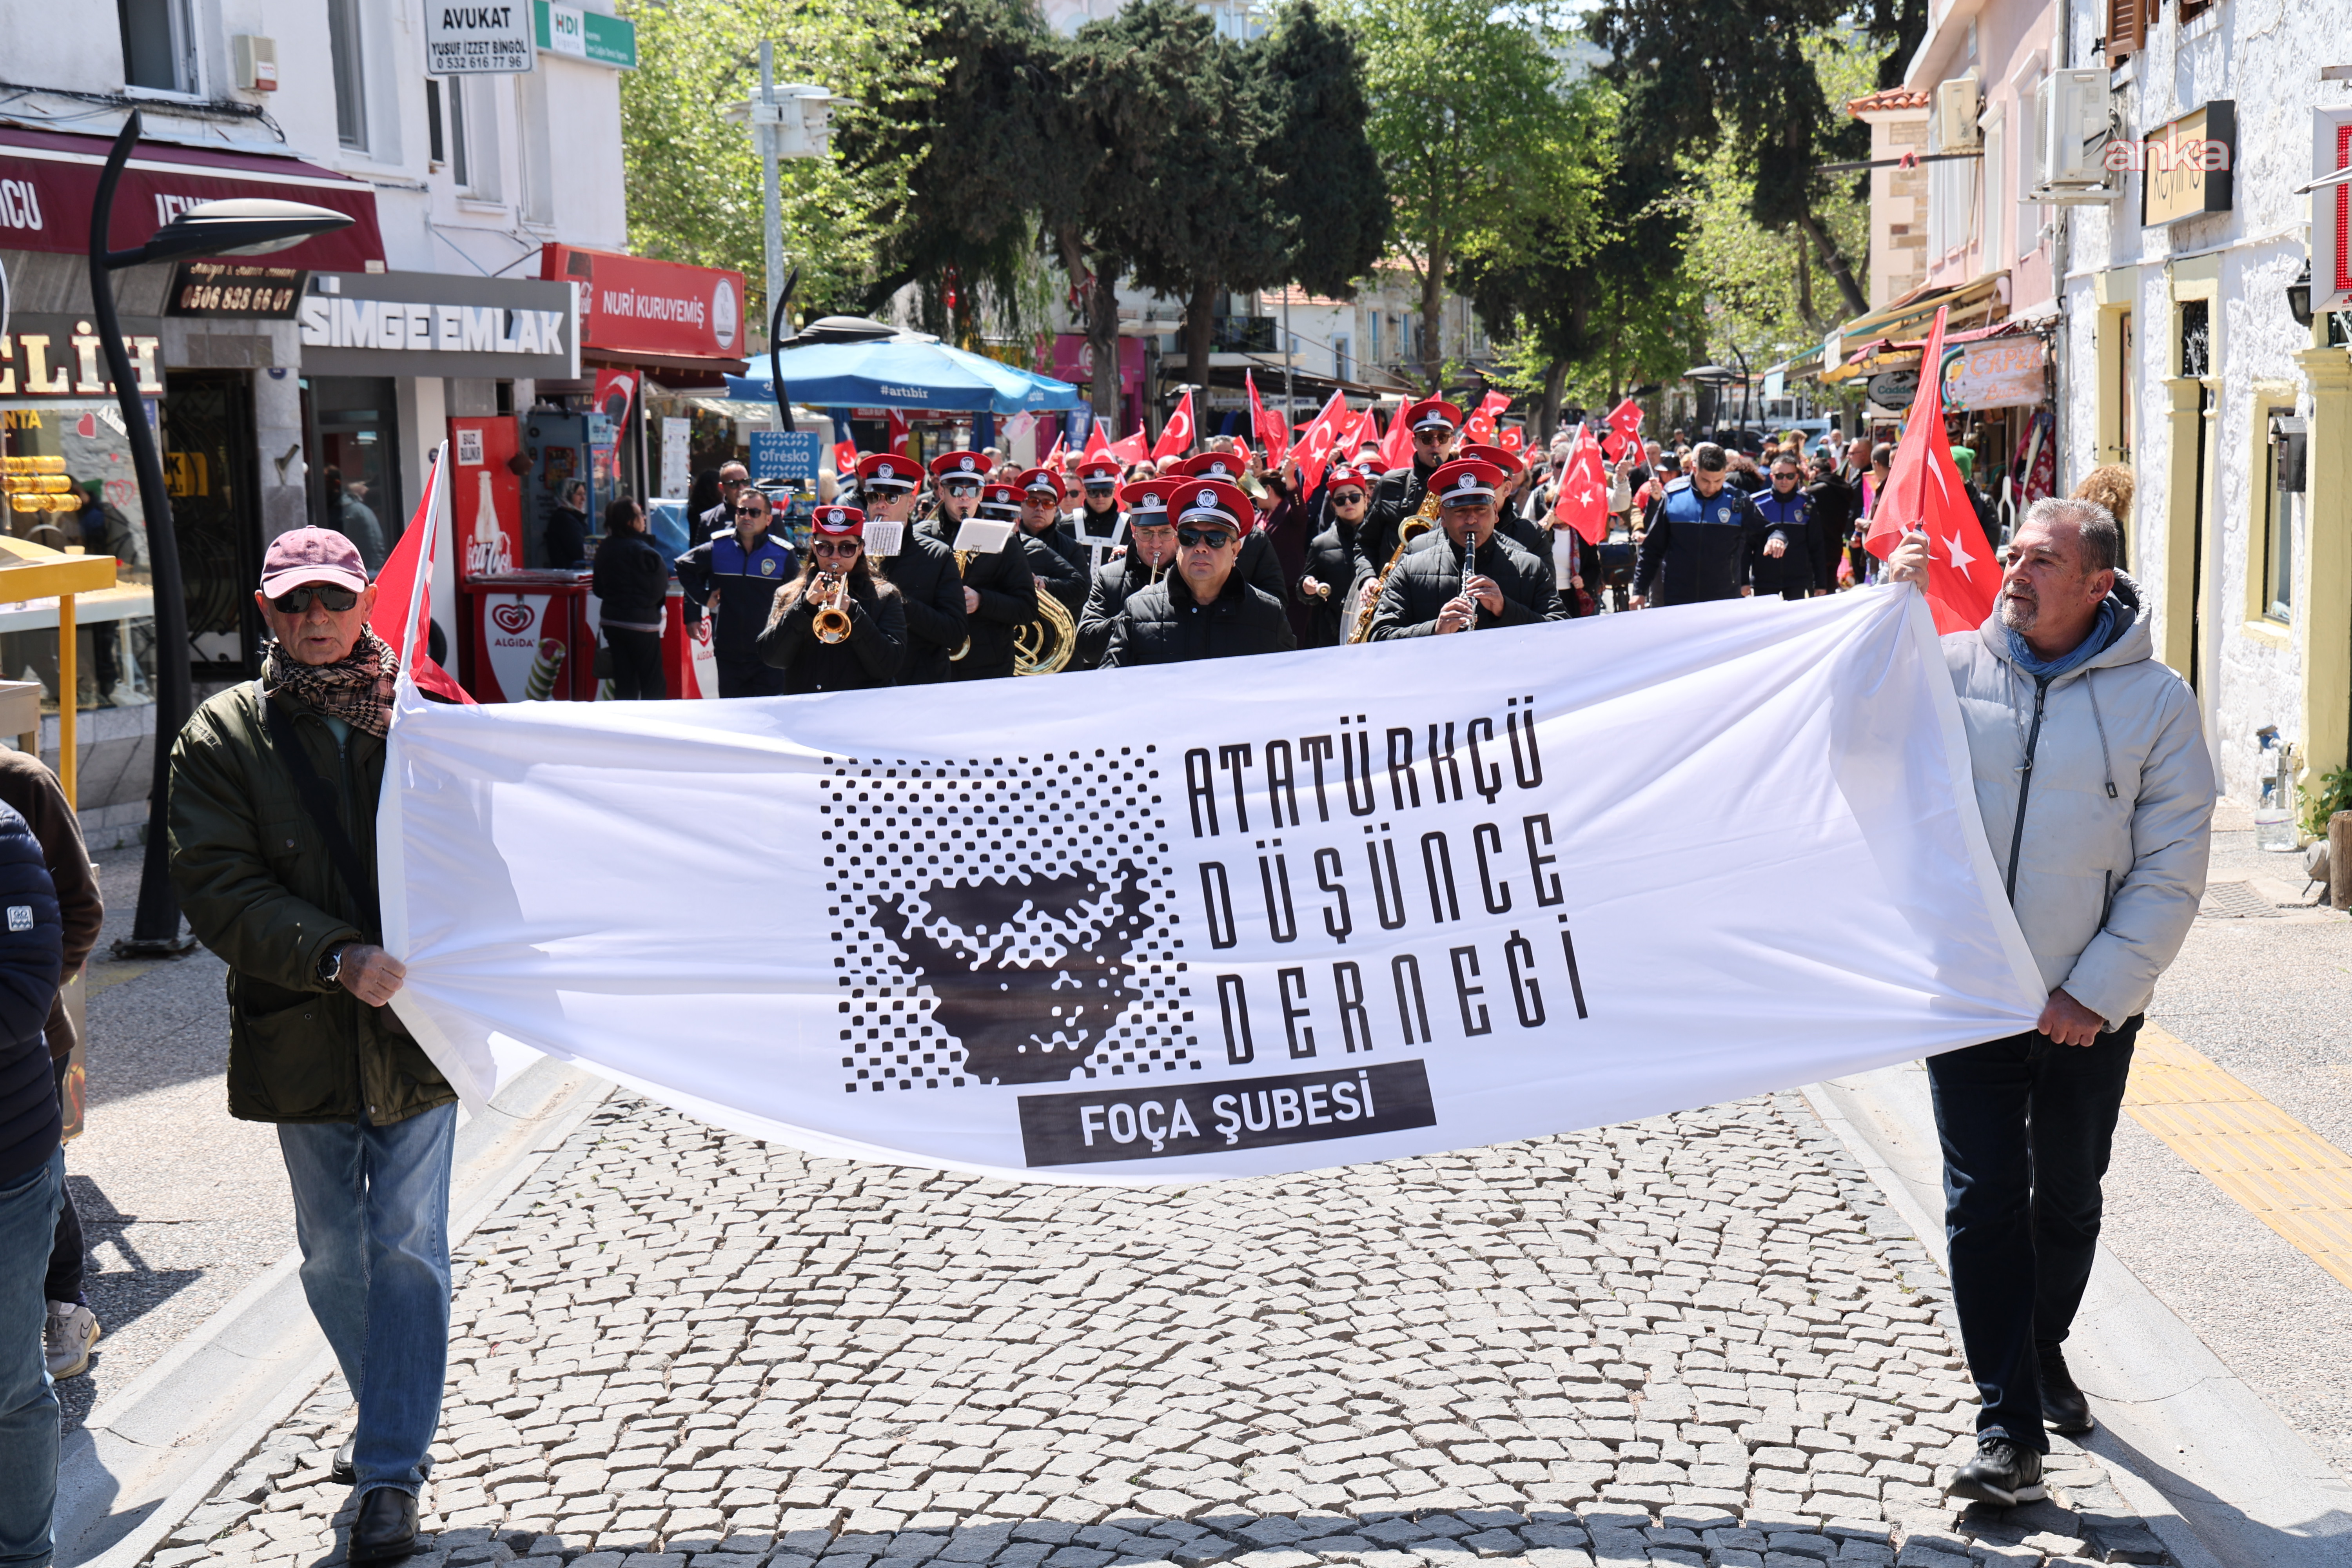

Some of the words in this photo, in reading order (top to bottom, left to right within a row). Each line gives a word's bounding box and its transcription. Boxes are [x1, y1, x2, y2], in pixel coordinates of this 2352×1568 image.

[443, 7, 511, 29] AVUKAT
[555, 13, 578, 36] HDI
[432, 42, 461, 55] YUSUF
[463, 39, 490, 54] İZZET
[492, 38, 526, 54] BİNGÖL
[437, 58, 443, 69] 0
[447, 57, 466, 69] 532
[470, 56, 489, 68] 616
[492, 56, 505, 68] 77
[509, 56, 522, 67] 96
[221, 286, 252, 310] 838
[252, 287, 273, 310] 66
[603, 288, 634, 317] NURİ
[637, 296, 704, 329] KURUYEMİŞ
[299, 276, 431, 350] SİMGE
[436, 305, 564, 354] EMLAK
[0, 408, 43, 430] NTA
[1185, 696, 1543, 838] ATATÜRKÇÜ
[1199, 813, 1564, 949] DÜŞÜNCE
[1217, 914, 1588, 1065] DERNEĞİ
[1081, 1099, 1200, 1152] FOÇA
[1213, 1070, 1374, 1144] ŞUBESİ
